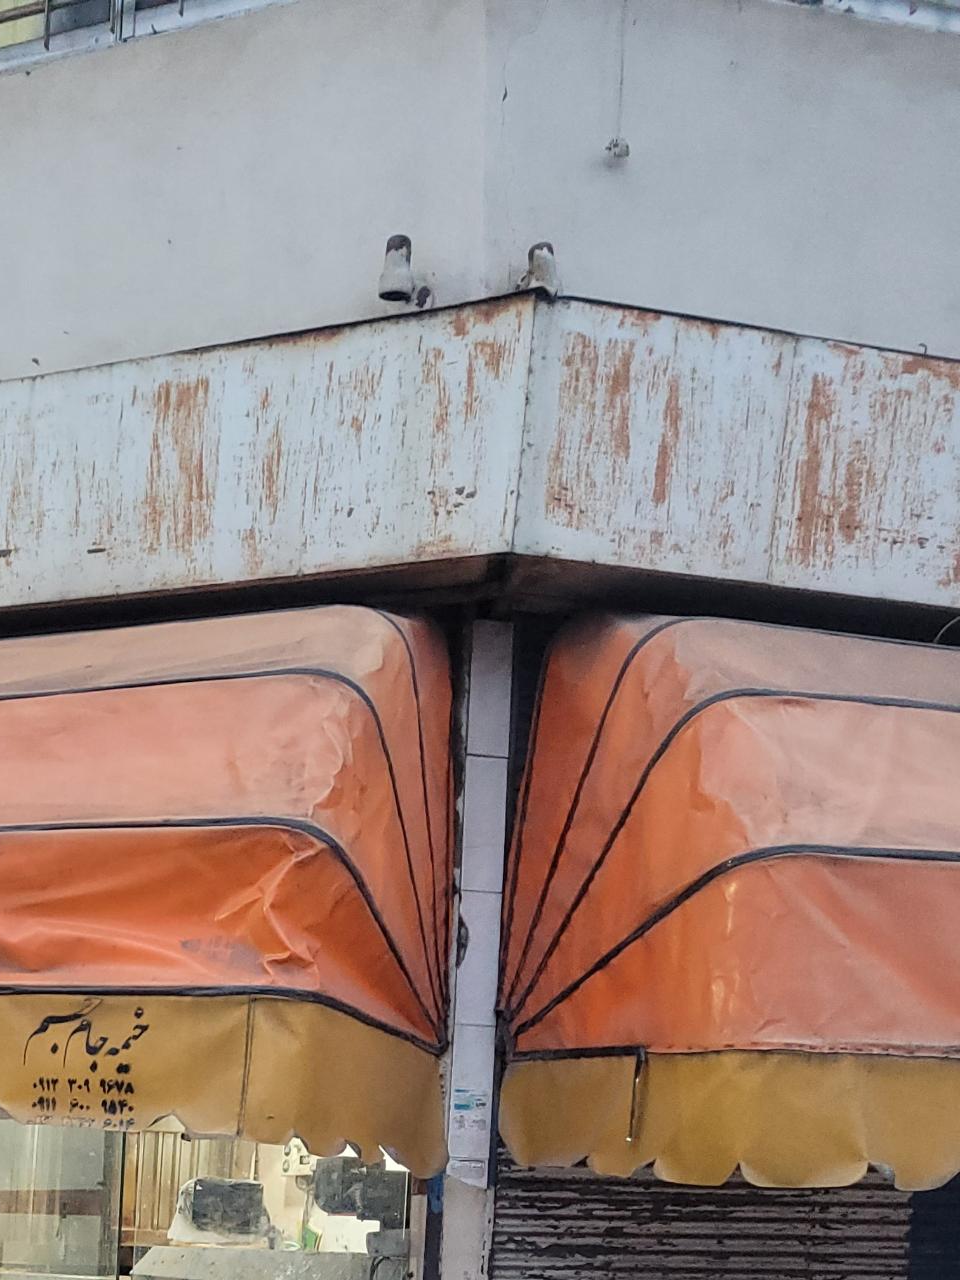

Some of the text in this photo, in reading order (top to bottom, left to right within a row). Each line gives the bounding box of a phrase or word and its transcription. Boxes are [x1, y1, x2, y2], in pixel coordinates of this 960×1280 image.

[63, 1019, 109, 1073] جام
[68, 1078, 90, 1093] ۳۰۹
[100, 1078, 135, 1094] ۹۶۷۸
